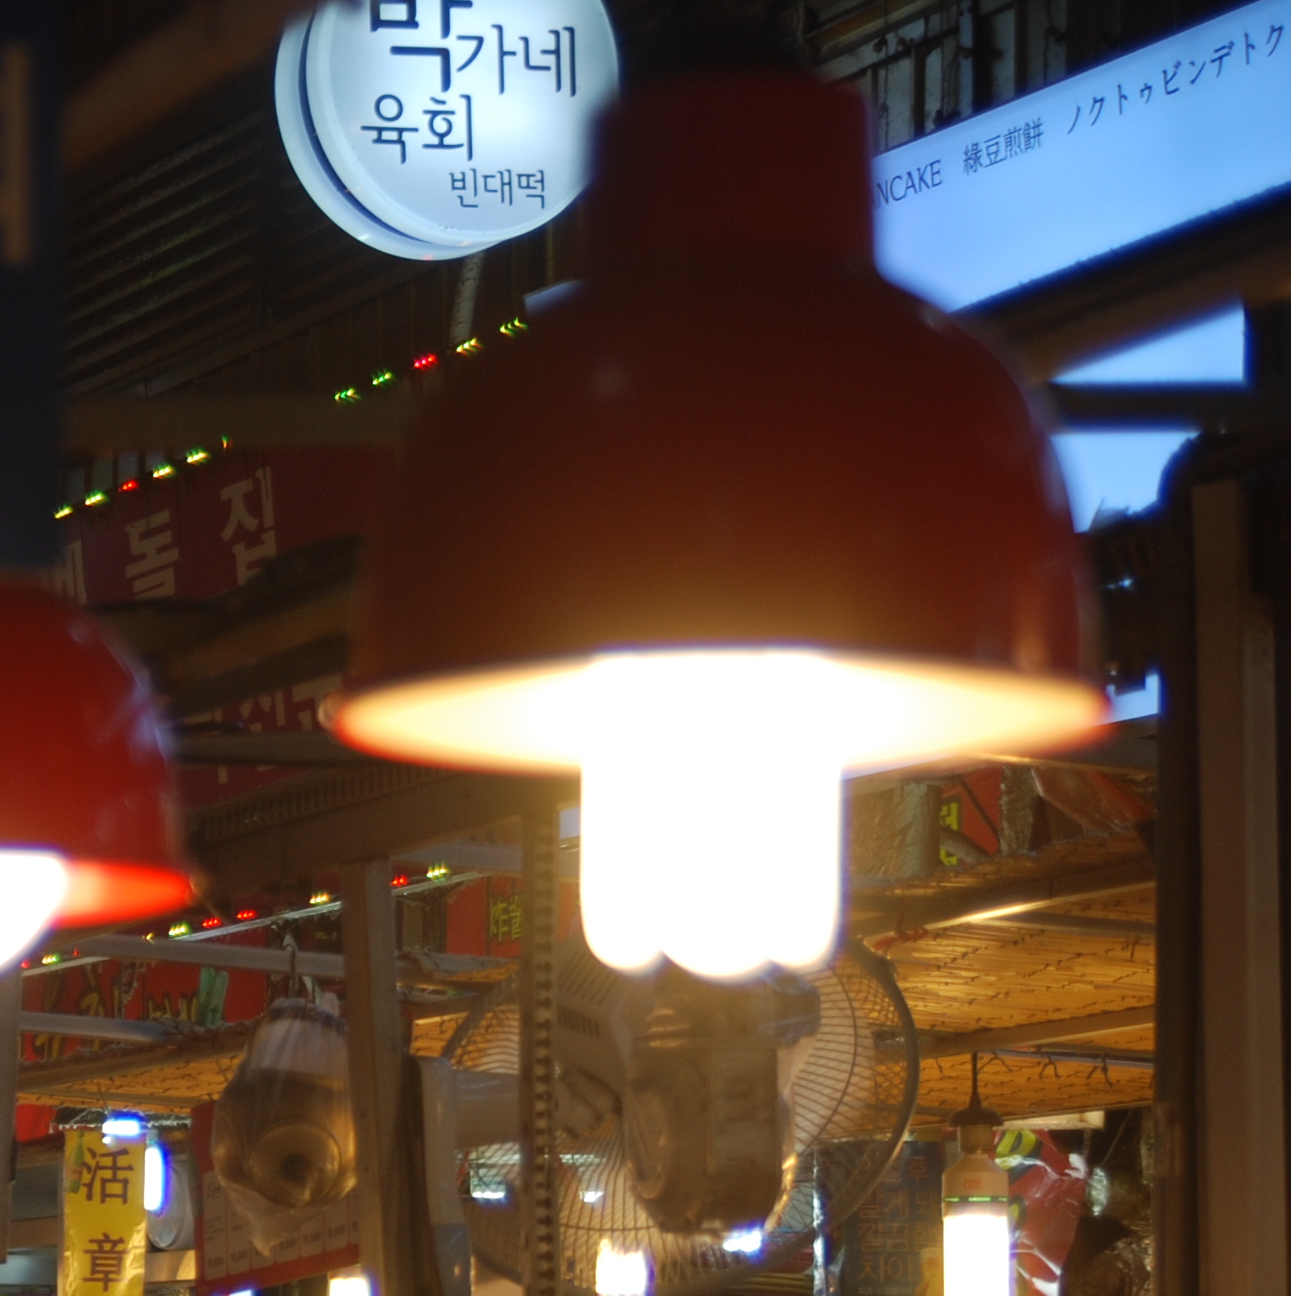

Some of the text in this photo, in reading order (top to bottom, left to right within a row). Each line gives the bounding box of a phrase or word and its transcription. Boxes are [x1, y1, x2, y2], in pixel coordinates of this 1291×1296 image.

[360, 94, 474, 165] 육회
[448, 167, 546, 211] 빈대떡
[873, 159, 943, 210] NCAKE
